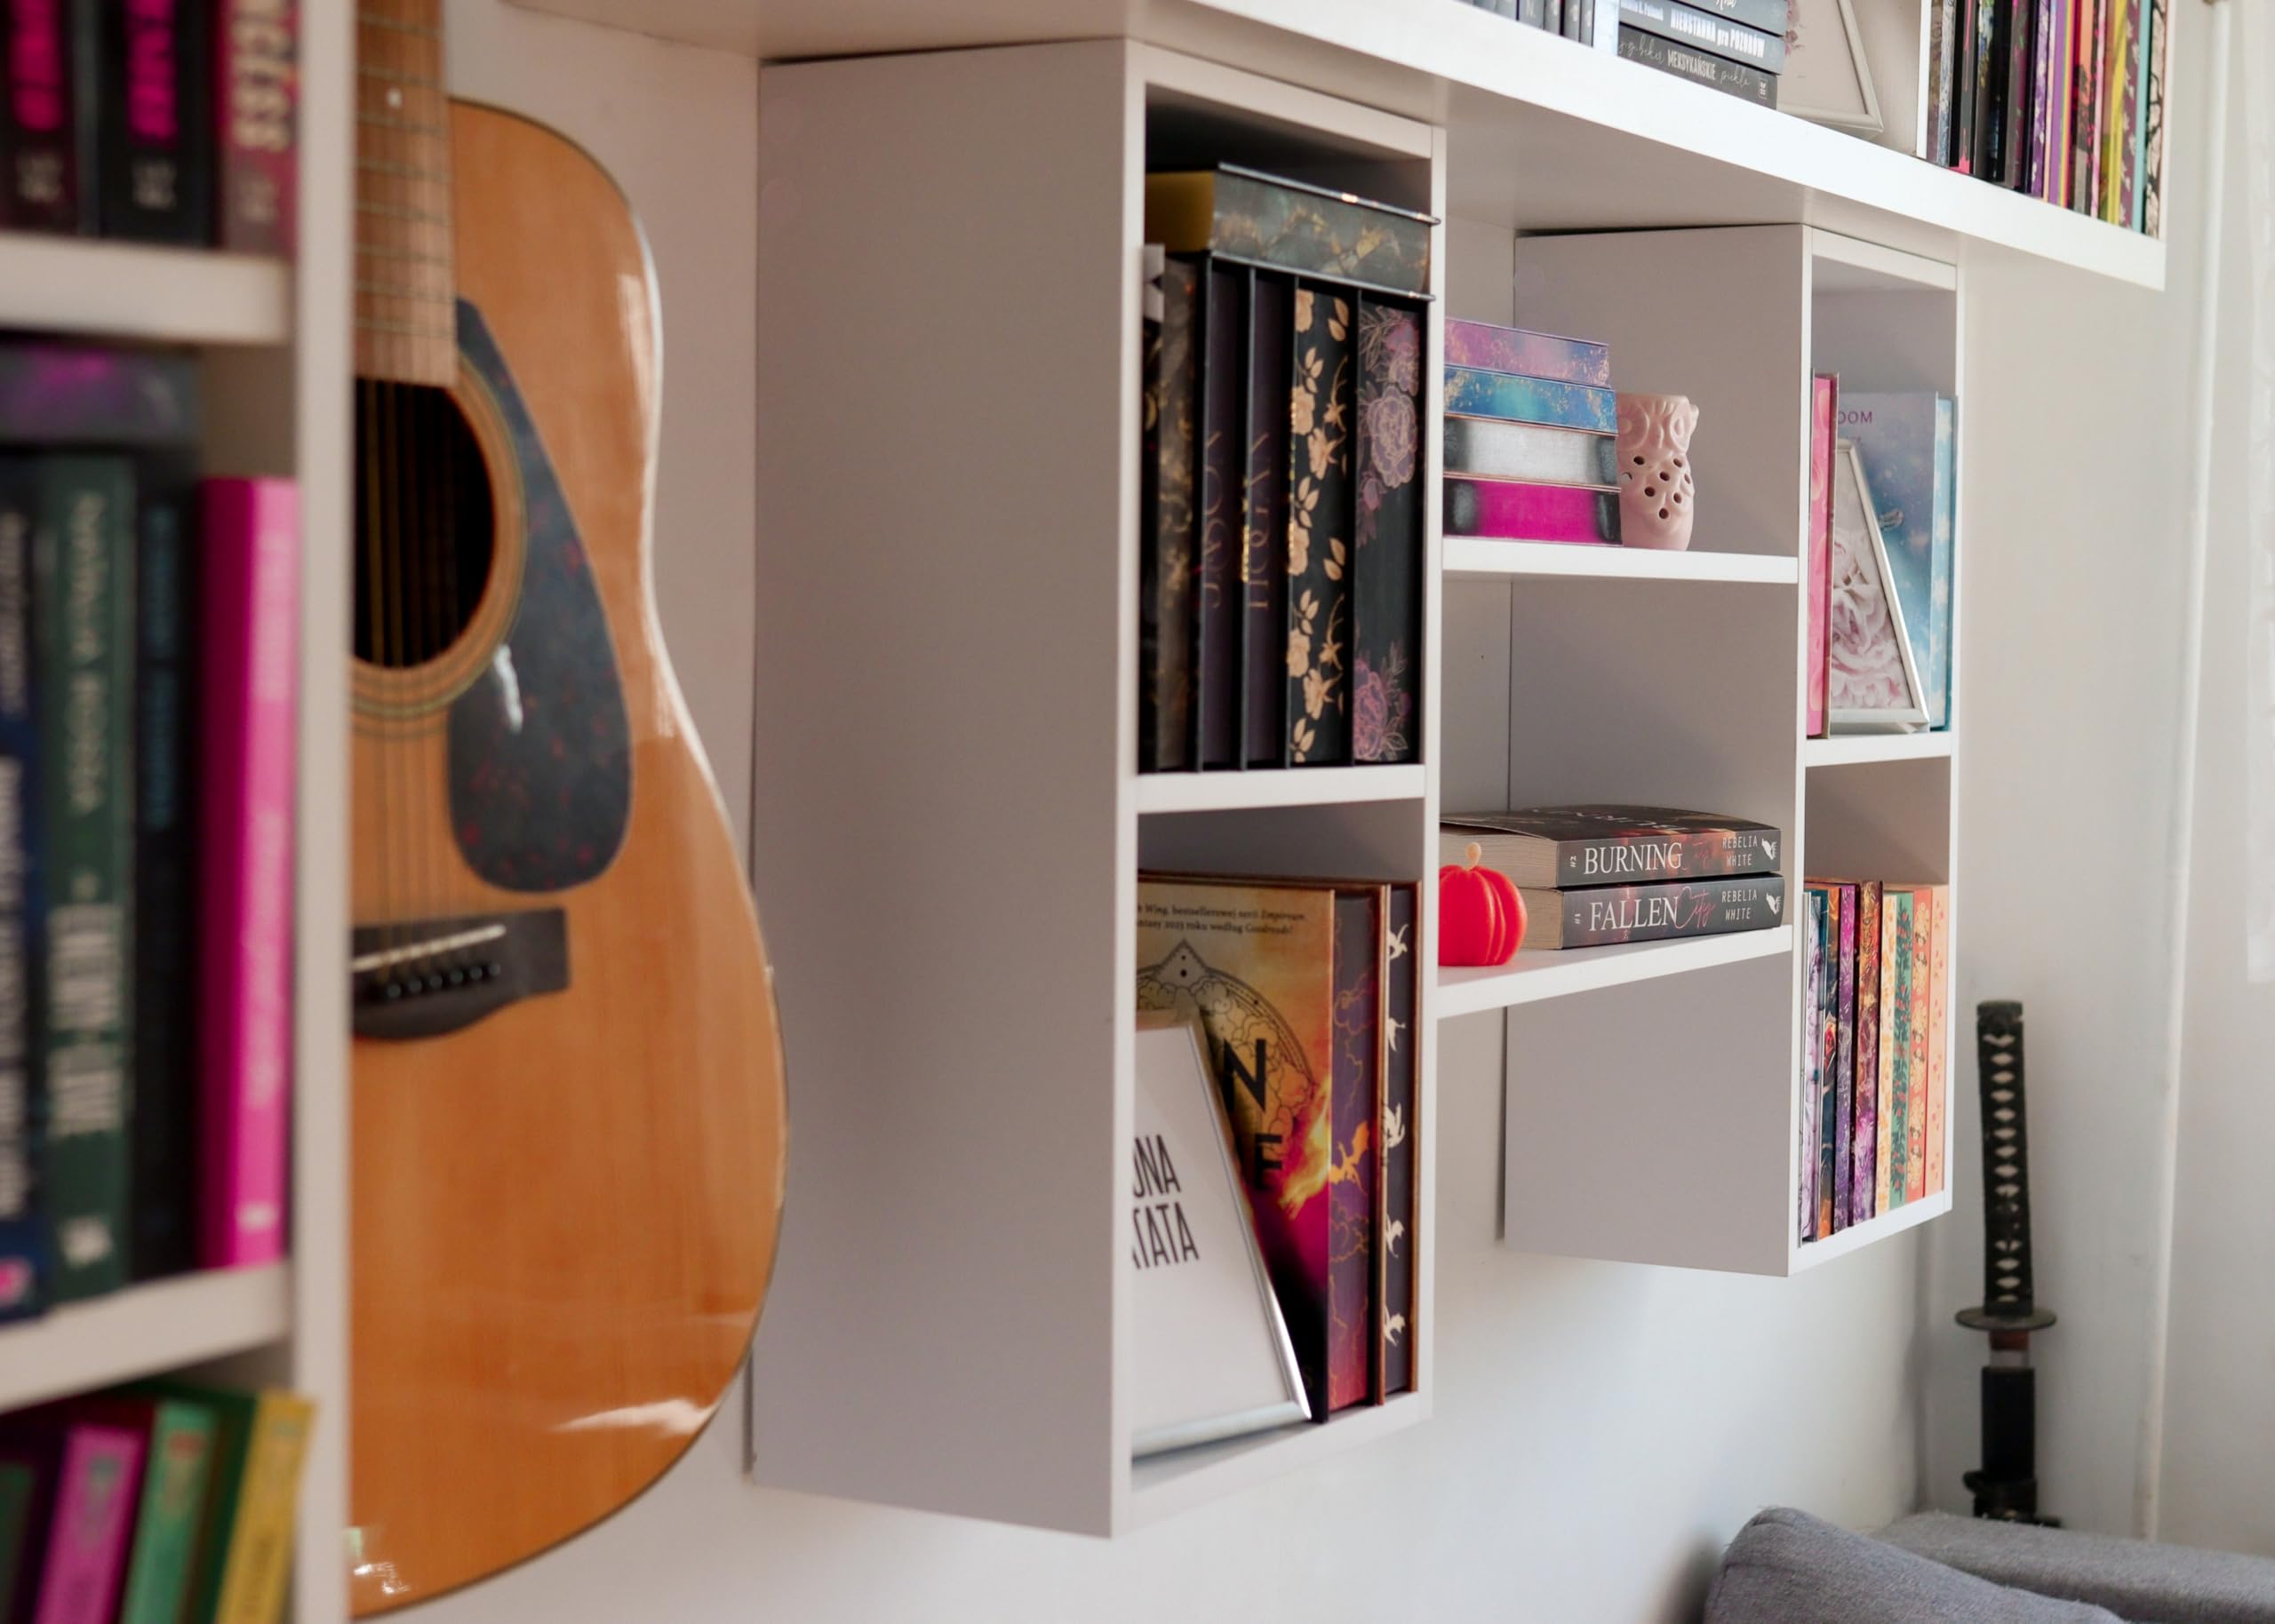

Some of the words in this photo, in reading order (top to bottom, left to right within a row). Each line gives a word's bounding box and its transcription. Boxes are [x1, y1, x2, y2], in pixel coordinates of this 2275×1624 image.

[1667, 49, 1716, 81] MEKSYKAŃSKIE
[1838, 410, 1872, 424] OOM
[1722, 835, 1758, 849] REBELIA
[1584, 842, 1683, 874] BURNING
[1727, 854, 1752, 867] WHITE
[1721, 889, 1758, 904] REBELIA
[1589, 896, 1679, 932] FALLEN
[1674, 886, 1716, 929] City
[1725, 909, 1752, 921] WHITE
[1134, 1134, 1181, 1198] UNA
[1133, 1202, 1200, 1269] TATA
